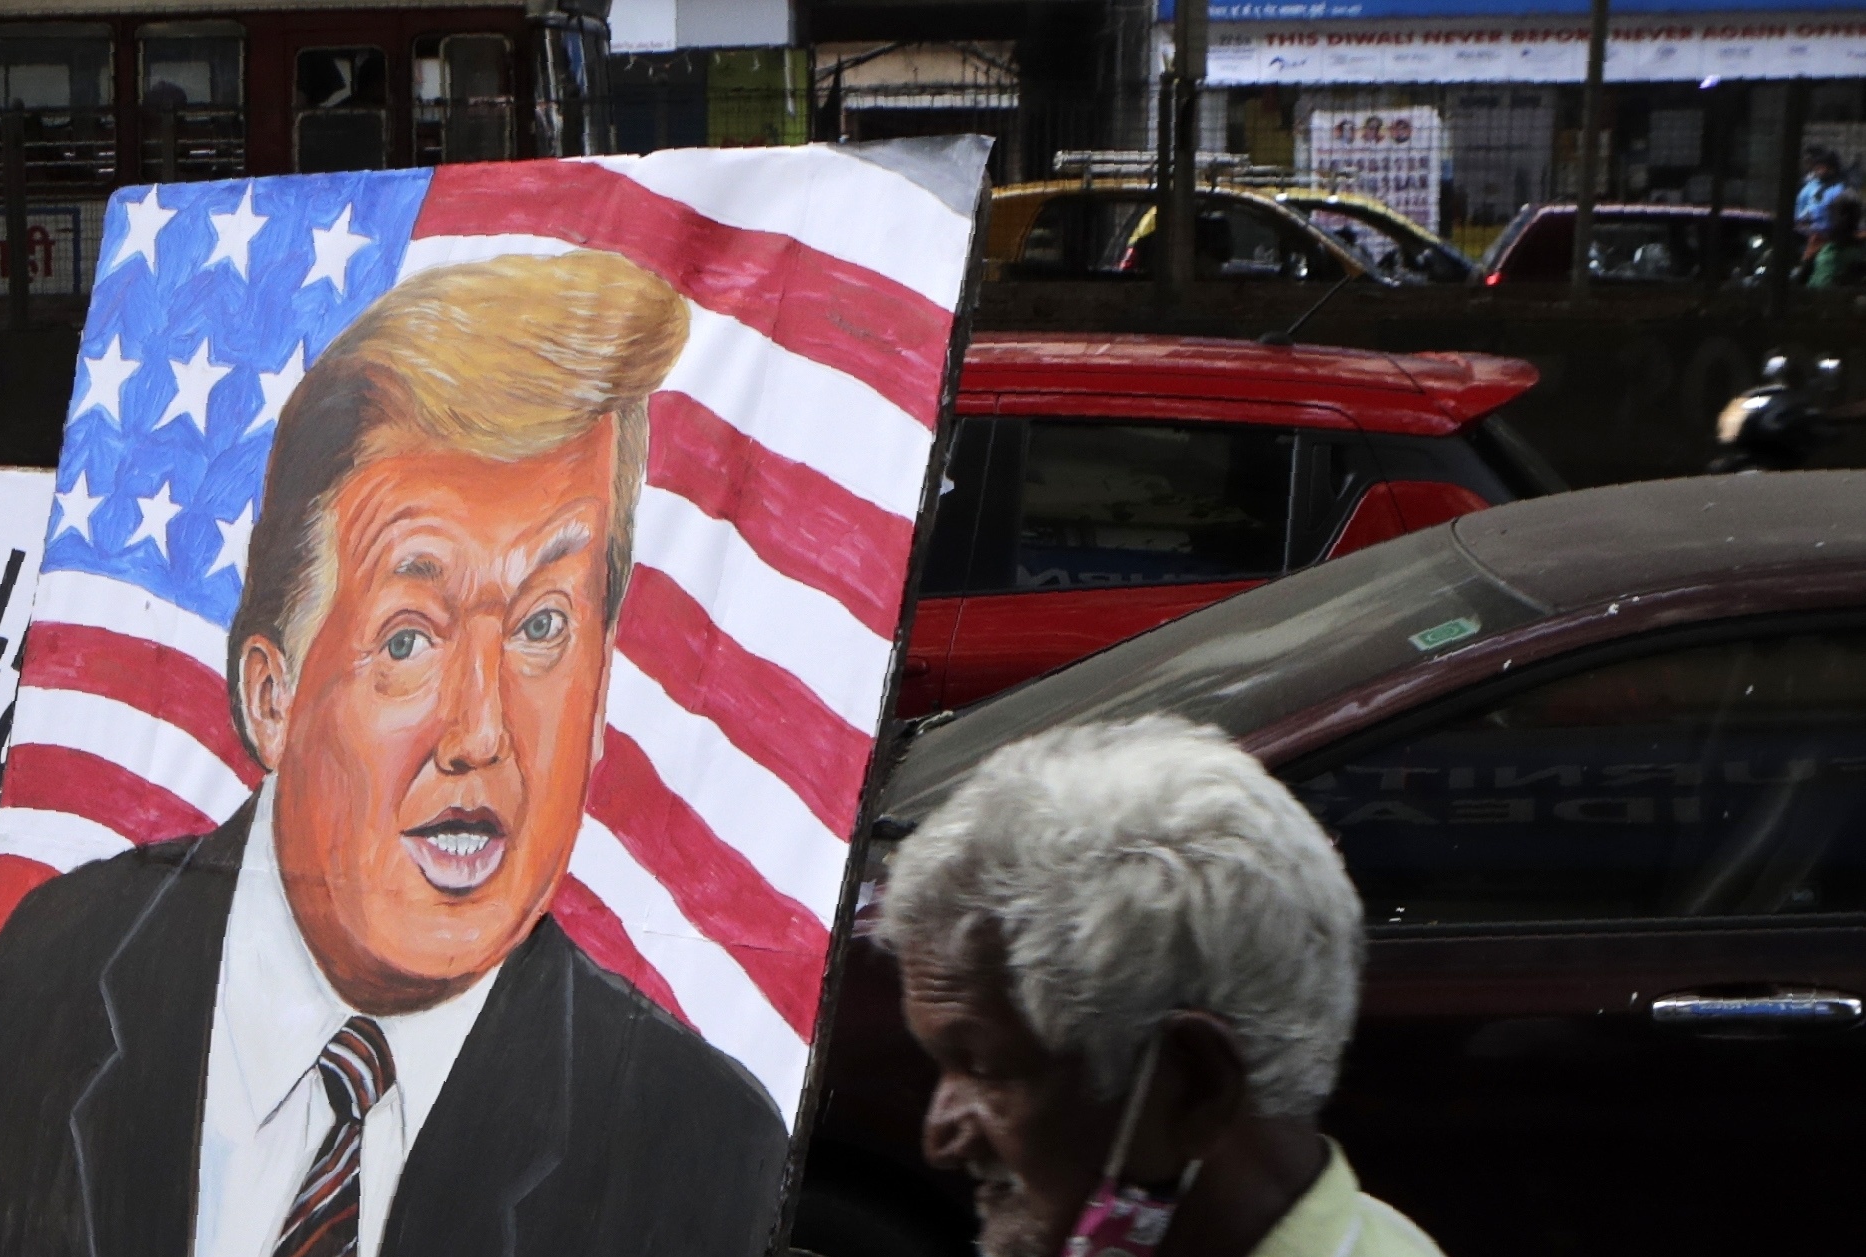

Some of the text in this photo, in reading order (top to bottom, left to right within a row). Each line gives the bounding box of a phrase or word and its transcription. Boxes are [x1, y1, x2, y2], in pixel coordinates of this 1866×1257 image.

[1265, 31, 1319, 47] THIS
[1326, 30, 1415, 46] DIWALI
[1422, 29, 1503, 45] NEVER
[1510, 27, 1592, 44] BEFOR
[1612, 25, 1693, 42] NEVER
[1702, 23, 1788, 41] AGAIN
